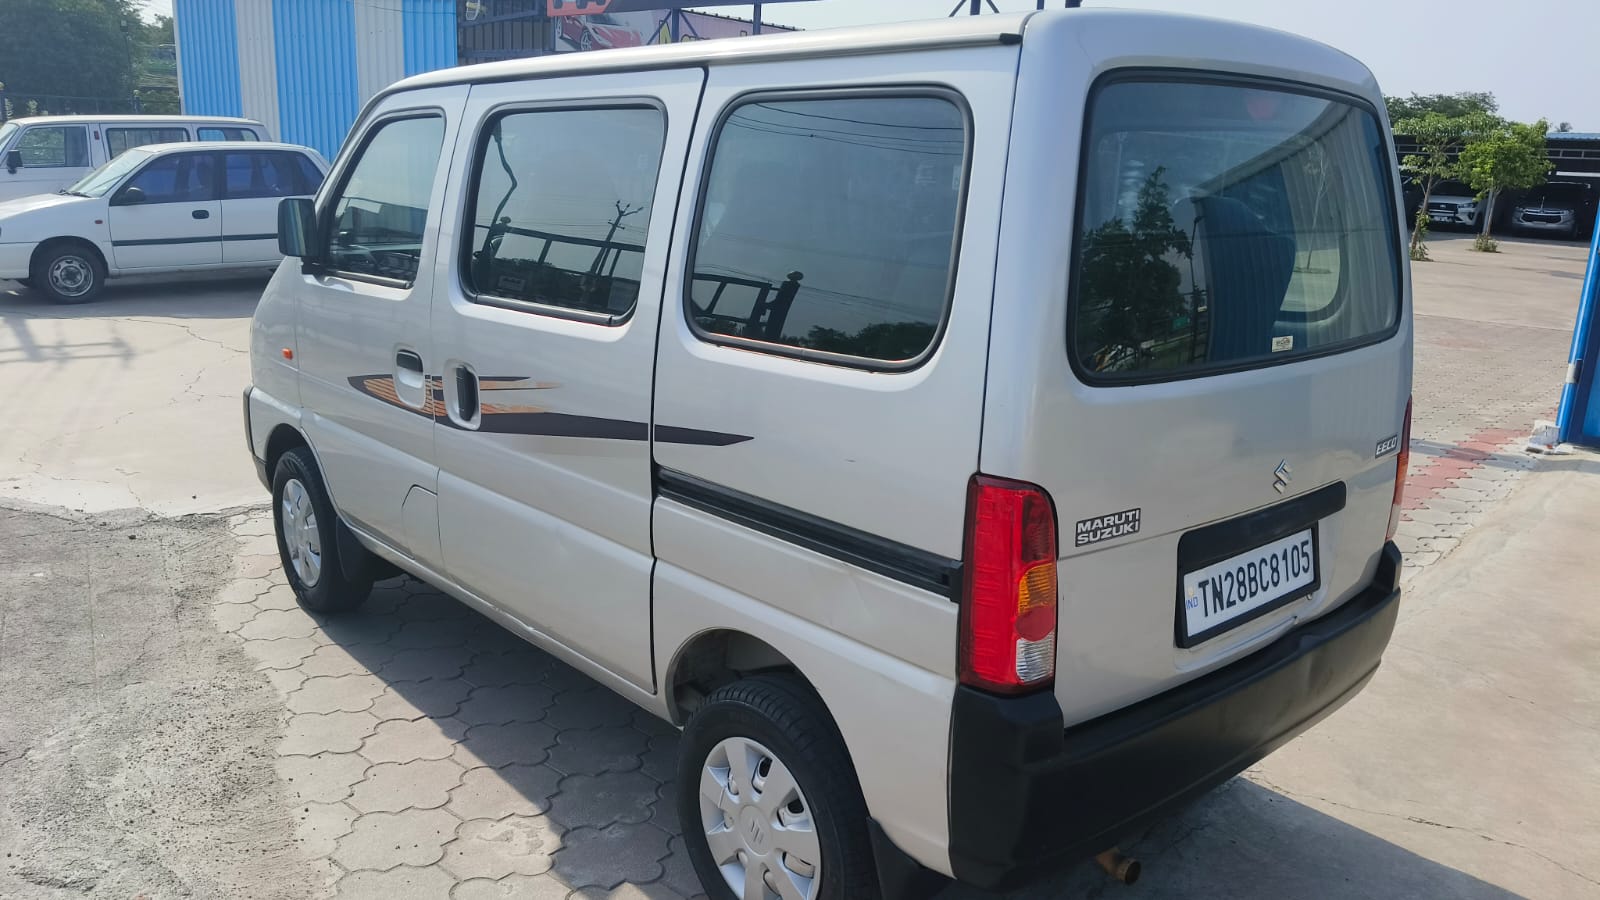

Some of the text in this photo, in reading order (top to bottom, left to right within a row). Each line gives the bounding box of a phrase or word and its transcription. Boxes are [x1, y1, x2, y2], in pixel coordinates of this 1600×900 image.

[1376, 437, 1397, 455] EECO
[1077, 509, 1140, 533] MARUTI
[1077, 521, 1139, 544] SUZUKI
[1198, 540, 1310, 618] TN28BC8105
[1185, 596, 1199, 609] IND
